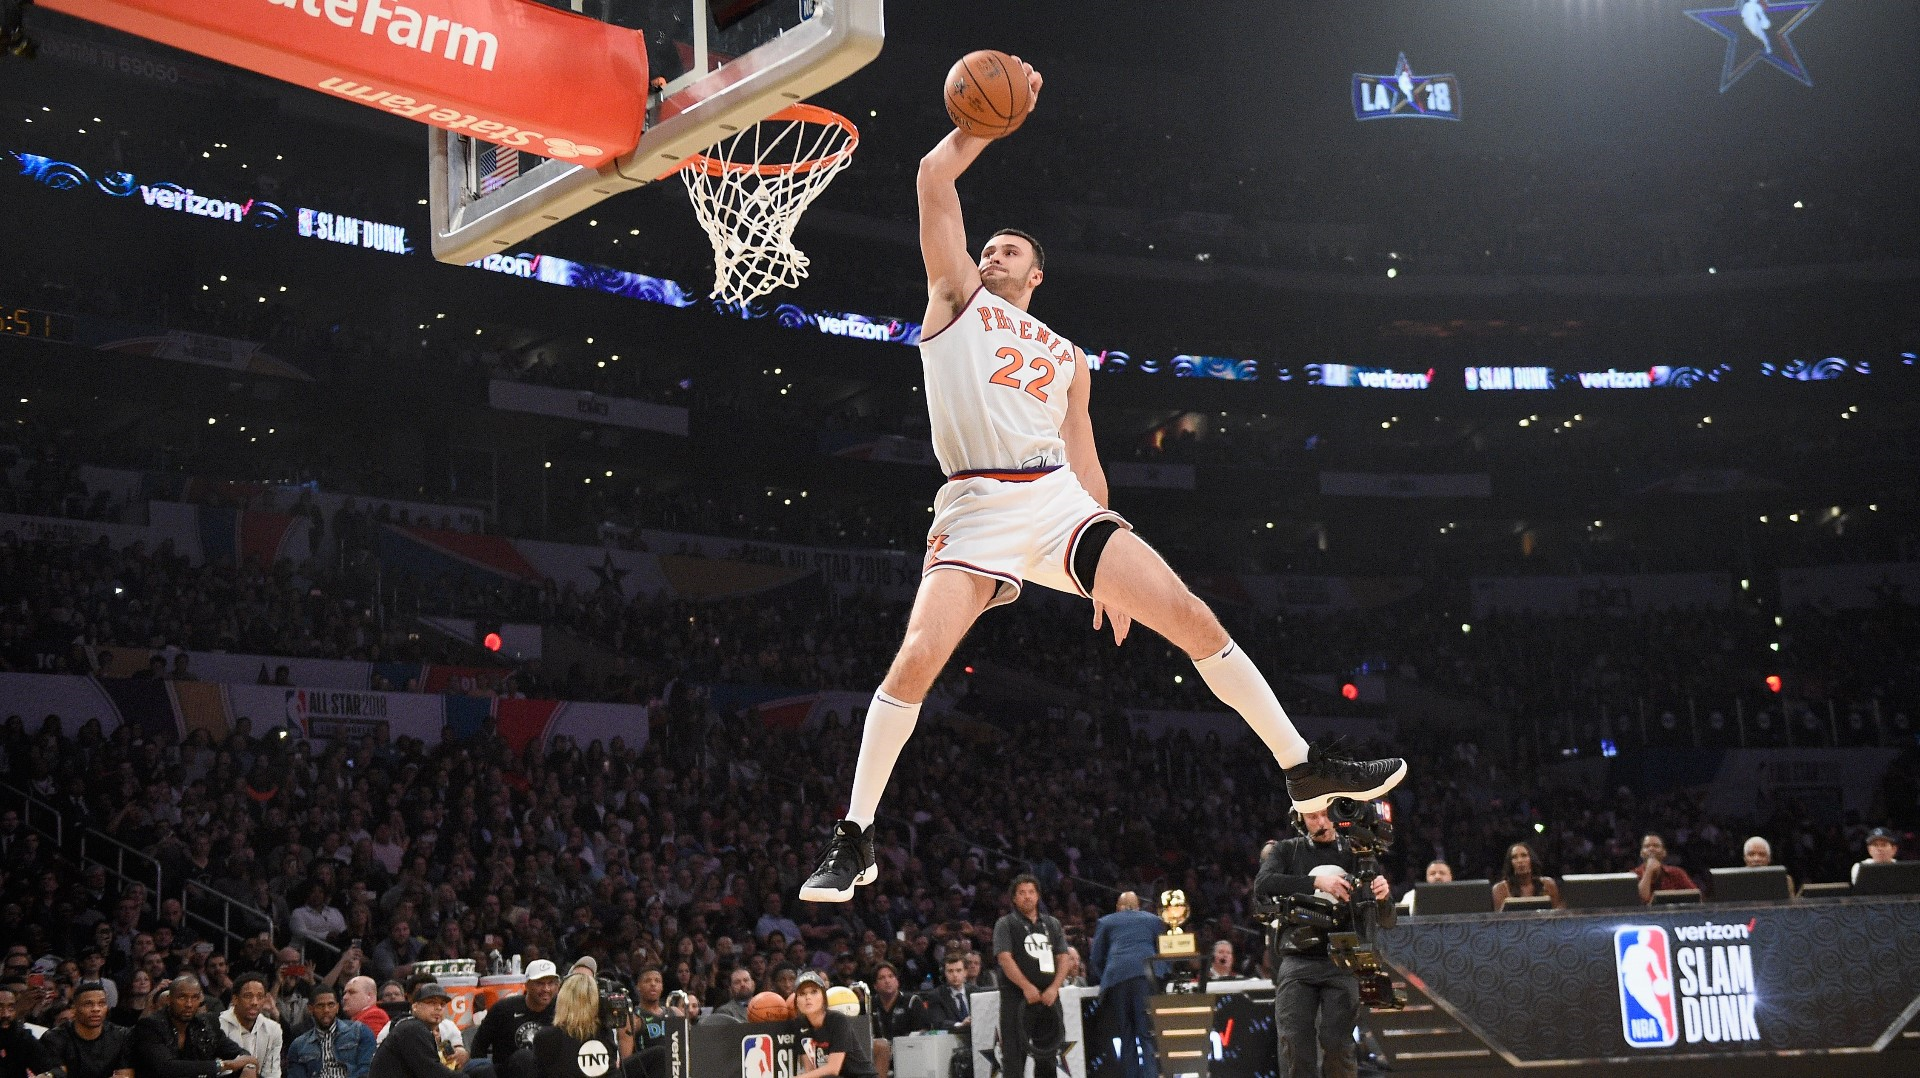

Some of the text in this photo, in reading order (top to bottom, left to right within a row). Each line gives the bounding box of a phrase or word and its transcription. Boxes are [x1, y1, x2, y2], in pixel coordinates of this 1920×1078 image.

[267, 0, 498, 72] eFarm
[118, 55, 178, 83] 69050
[1361, 83, 1390, 111] LA
[1425, 83, 1451, 111] 18
[140, 184, 243, 222] verizon
[316, 212, 406, 254] SLAM DUNK
[466, 254, 532, 278] izon
[0, 304, 51, 337] :51
[818, 312, 890, 342] verizon
[989, 347, 1056, 403] 22
[1358, 369, 1429, 389] verizon
[1479, 367, 1549, 390] SLAM DUNK
[1579, 367, 1650, 389] verizon
[812, 552, 851, 584] STAR
[853, 556, 890, 586] 2018
[309, 691, 387, 718] ALL STAR 2018
[1675, 921, 1748, 941] verizon
[1677, 945, 1754, 996] SLAM
[451, 996, 466, 1013] G
[1682, 994, 1760, 1043] DUNK
[1631, 1018, 1659, 1039] NBA
[579, 1053, 609, 1067] TNT
[671, 1030, 682, 1078] veriz
